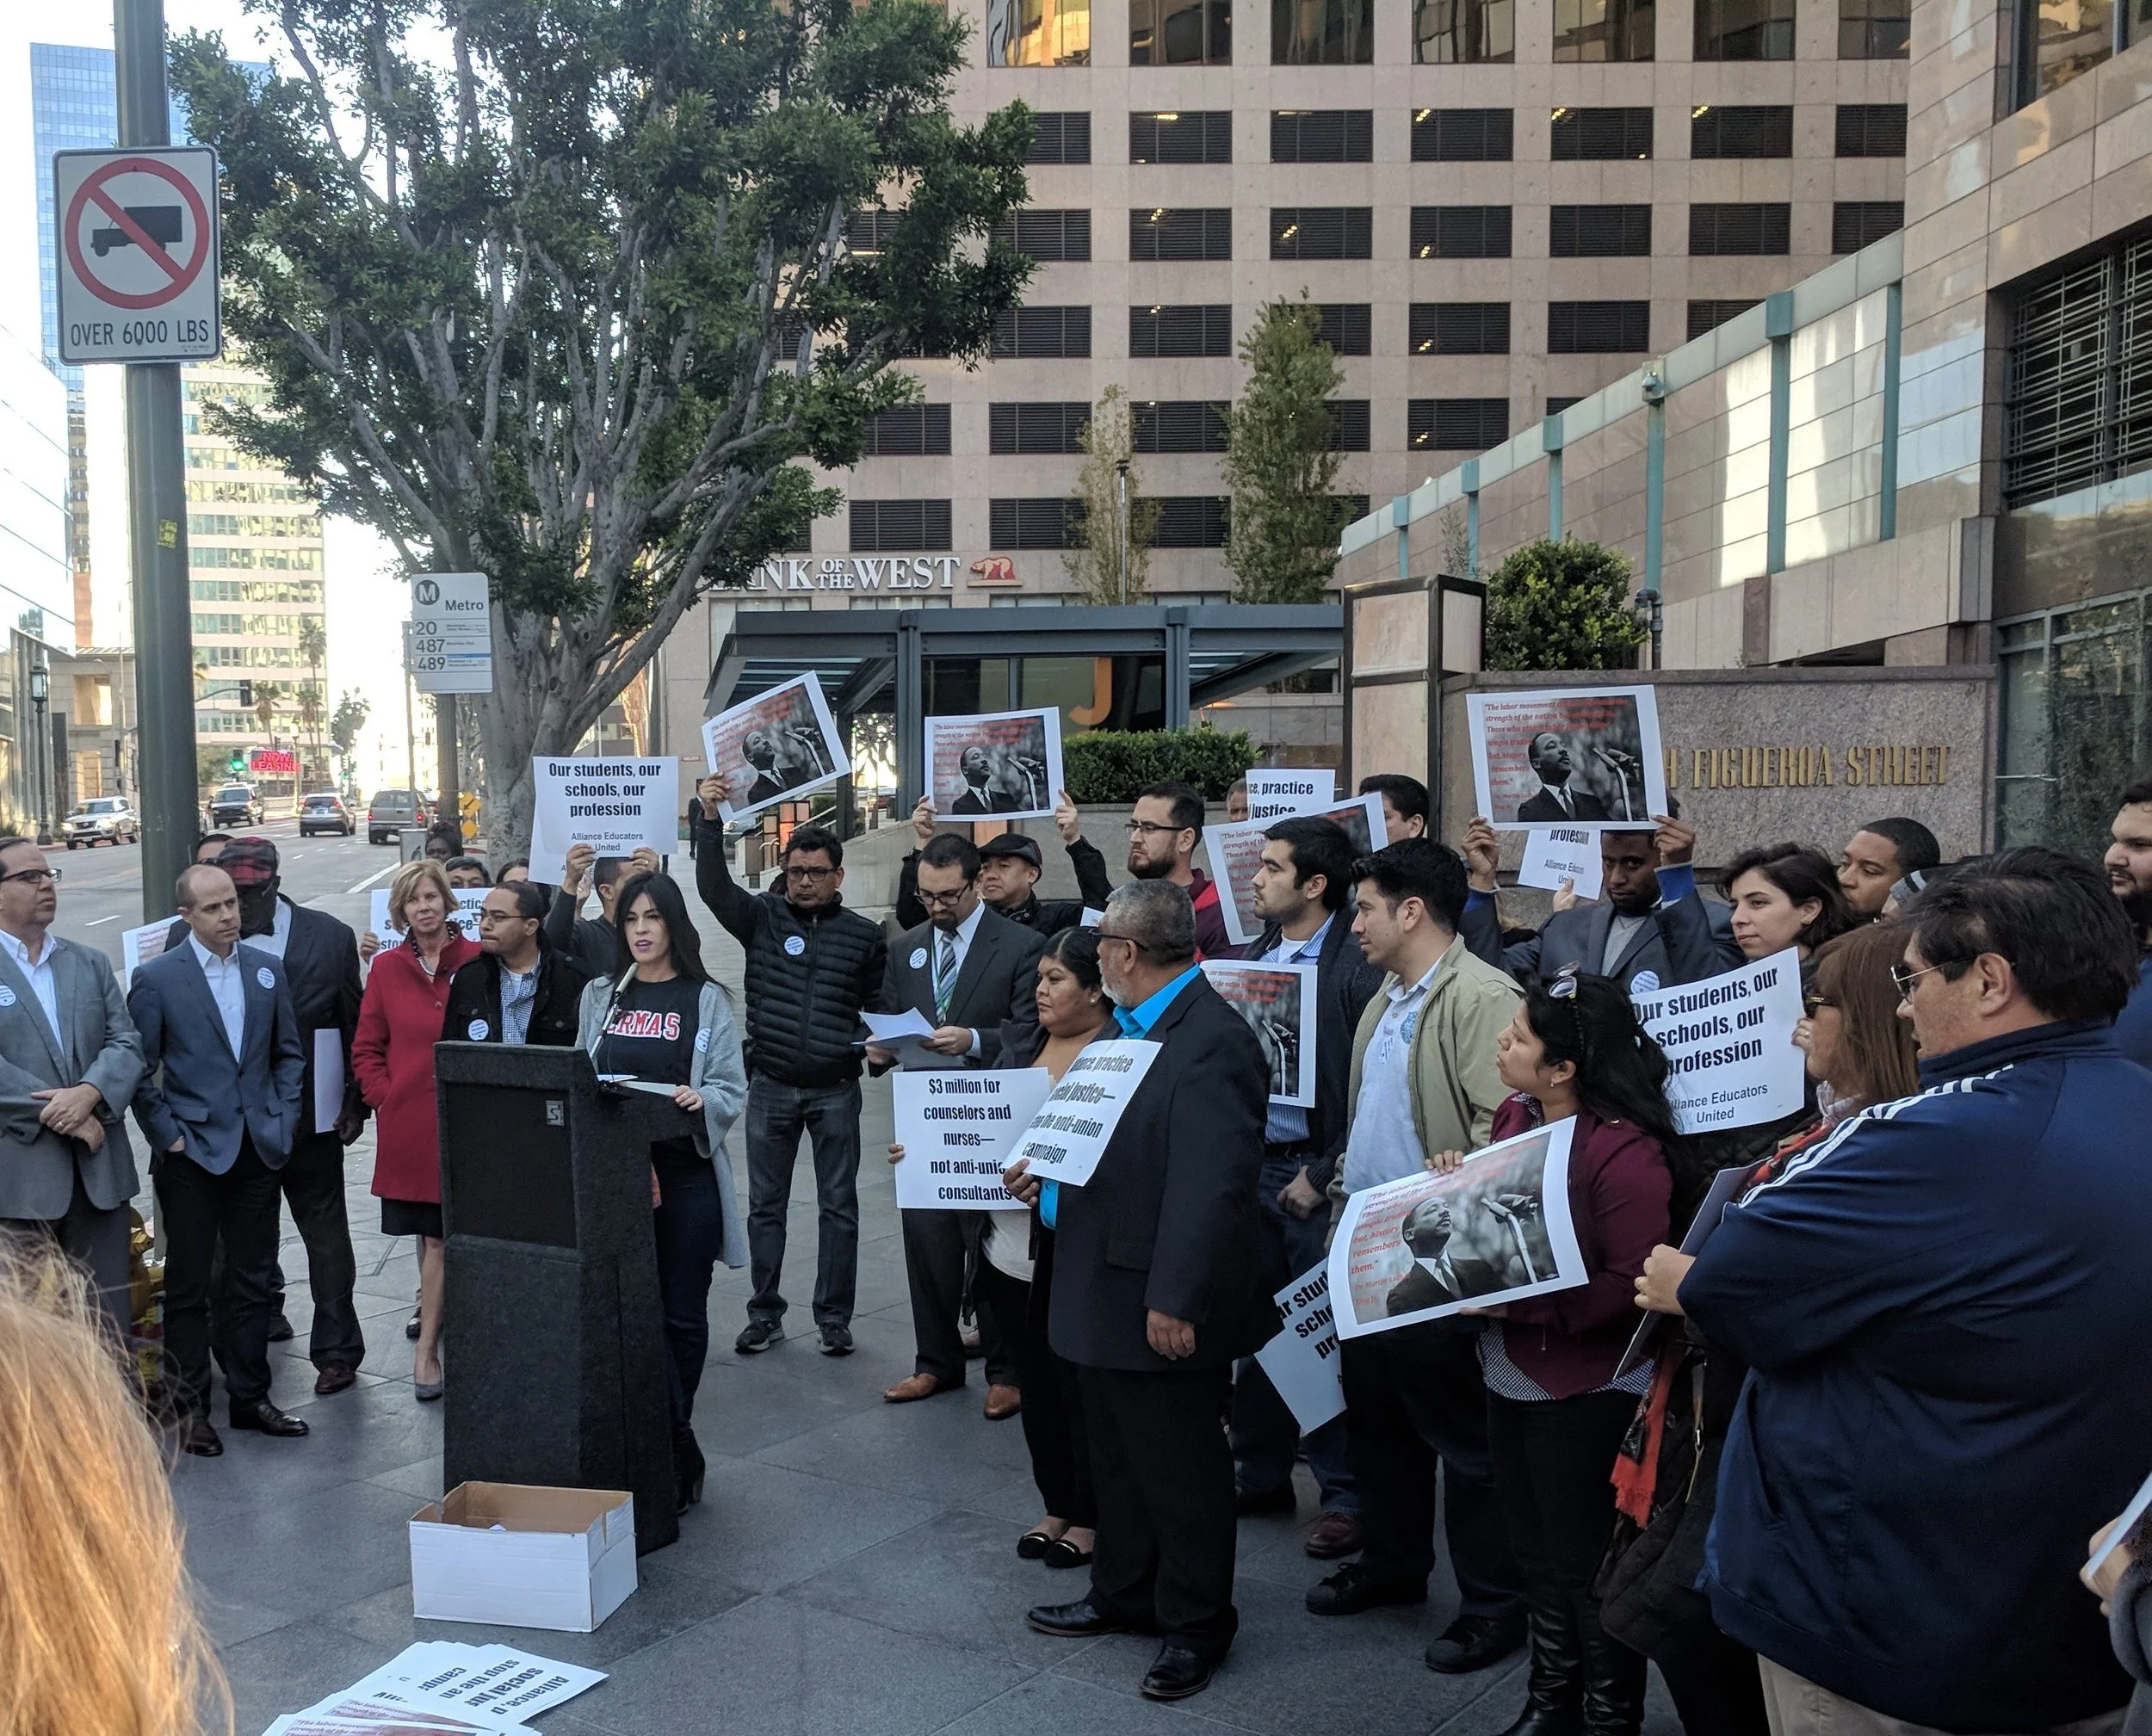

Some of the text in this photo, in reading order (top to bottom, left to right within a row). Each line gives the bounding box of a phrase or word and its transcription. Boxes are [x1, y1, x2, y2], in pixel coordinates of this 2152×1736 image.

[71, 319, 208, 346] OVER 6000 LBS
[708, 557, 962, 590] NK OF THE WEST
[445, 600, 484, 611] Metro
[416, 621, 436, 635] 20
[416, 639, 446, 653] 487
[417, 657, 446, 670] 489
[1486, 714, 1512, 723] strength
[1514, 714, 1521, 722] of
[261, 751, 292, 761] NOW
[549, 763, 661, 779] Our students, our
[1692, 745, 1834, 788] FIGUEROA
[1846, 744, 1951, 787] STREET
[565, 783, 646, 797] schools, our
[1262, 782, 1314, 795] practice
[570, 803, 641, 818] profession
[572, 832, 644, 841] Alliance Educators
[1224, 841, 1249, 849] strength
[1250, 839, 1257, 848] of
[1549, 830, 1589, 844] profes
[1544, 859, 1567, 871] Alliance
[461, 898, 484, 910] ctic
[1633, 1001, 1663, 1022] Our
[1668, 979, 1751, 1016] students,
[1753, 967, 1778, 991] our
[607, 1010, 681, 1041] RMAS
[1656, 1005, 1765, 1047] schools, our
[1092, 1054, 1134, 1073] practice
[929, 1078, 1000, 1095] $3 million for
[1671, 1084, 1768, 1110] liance Educators
[924, 1104, 1011, 1121] counselors and
[1697, 1107, 1735, 1123] United
[1052, 1115, 1104, 1138] anti-union
[1022, 1142, 1067, 1165] campaign
[931, 1160, 1006, 1176] not anti-unio
[938, 1185, 1012, 1201] consultants
[1370, 1226, 1400, 1239] history
[1353, 1239, 1401, 1258] remembers
[484, 1659, 520, 1677] stop
[417, 1667, 467, 1691] camp
[463, 1675, 491, 1689] the
[489, 1667, 544, 1696] social
[501, 1676, 570, 1707] Alliance,
